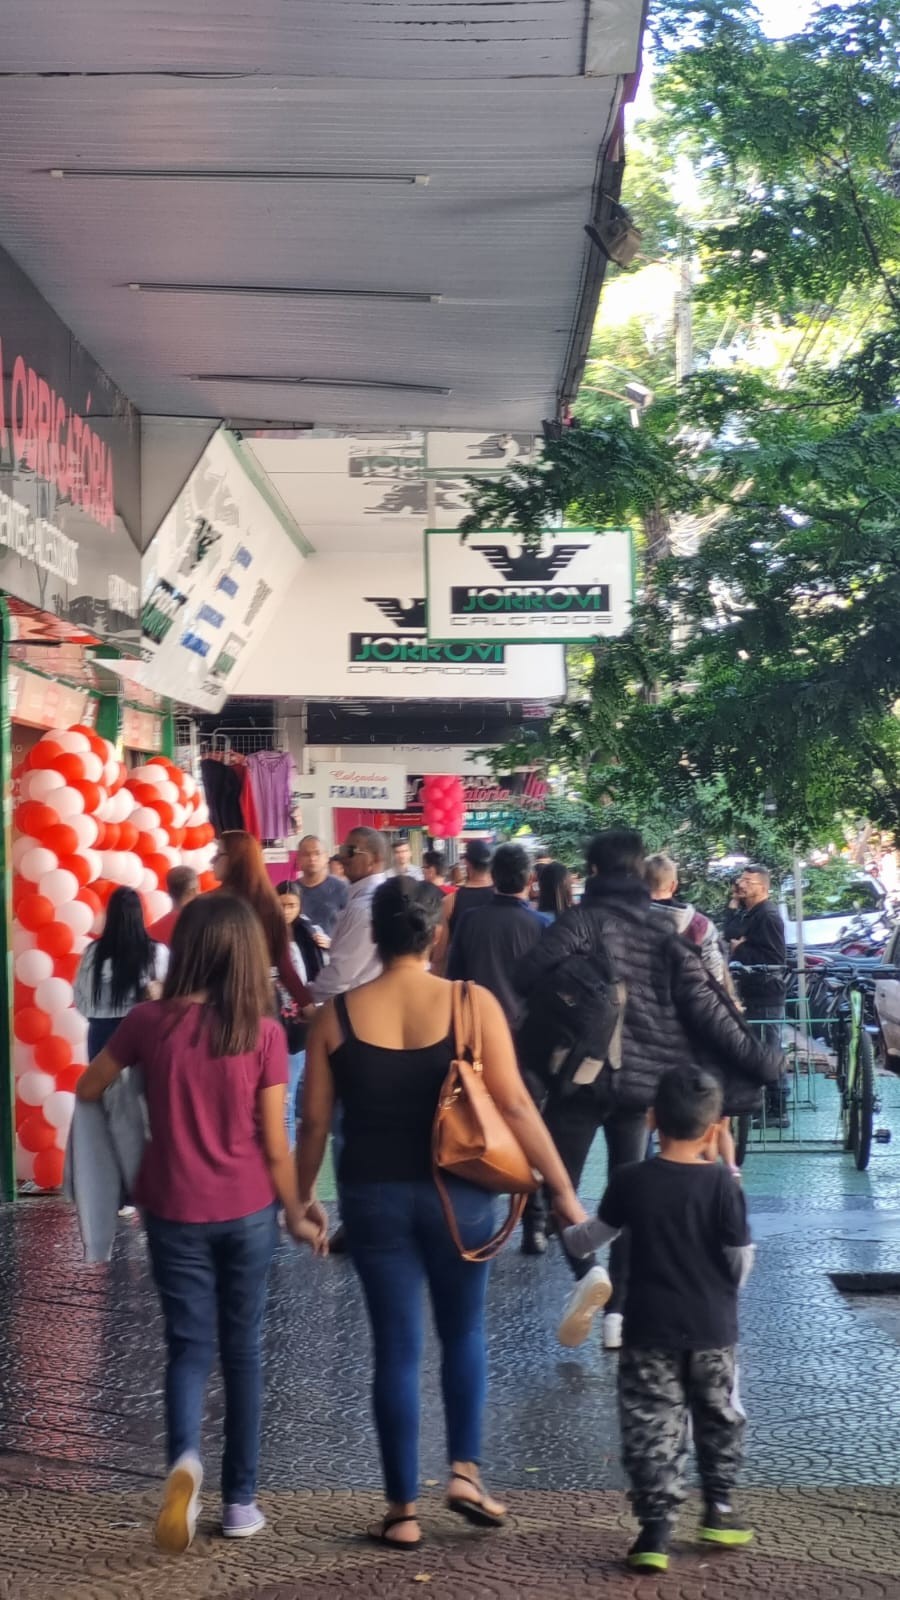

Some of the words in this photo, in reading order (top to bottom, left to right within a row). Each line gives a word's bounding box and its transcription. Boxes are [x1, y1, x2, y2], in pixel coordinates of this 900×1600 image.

[11, 355, 116, 533] OBRIGATÓRIA
[463, 586, 603, 611] JORROVI
[450, 615, 614, 627] CALÇADOS
[347, 665, 508, 675] CALÇADOS
